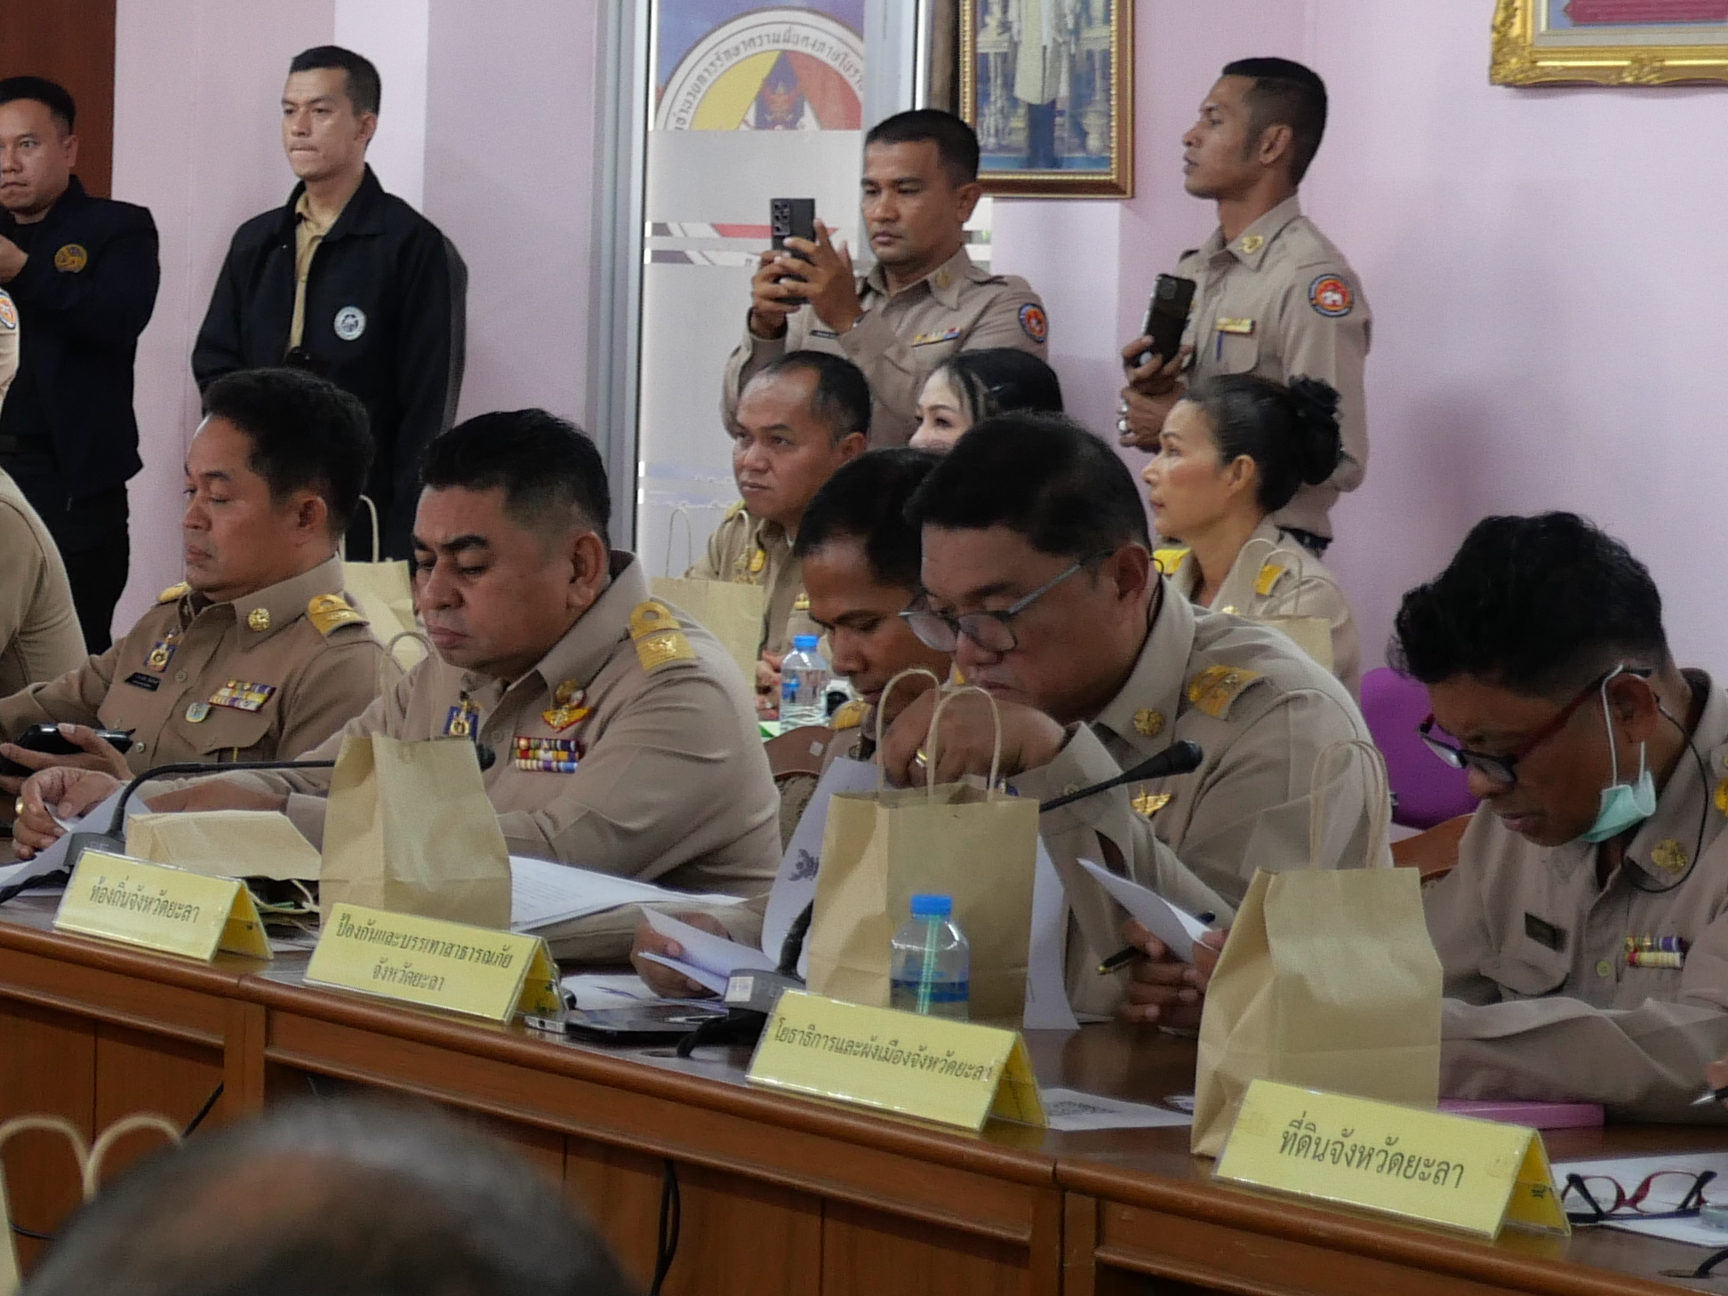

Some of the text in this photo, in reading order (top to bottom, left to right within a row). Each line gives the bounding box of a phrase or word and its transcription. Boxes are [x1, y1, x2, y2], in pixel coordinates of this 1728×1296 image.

[89, 875, 200, 923] ท้องถิ่นจังหวัดยะลา
[336, 912, 514, 969] ป้องกันและบรรเทาสาธารณภัย
[372, 957, 445, 991] จังหวัดยะลา
[1279, 1111, 1464, 1189] ที่ดินจังหวัดยะลา
